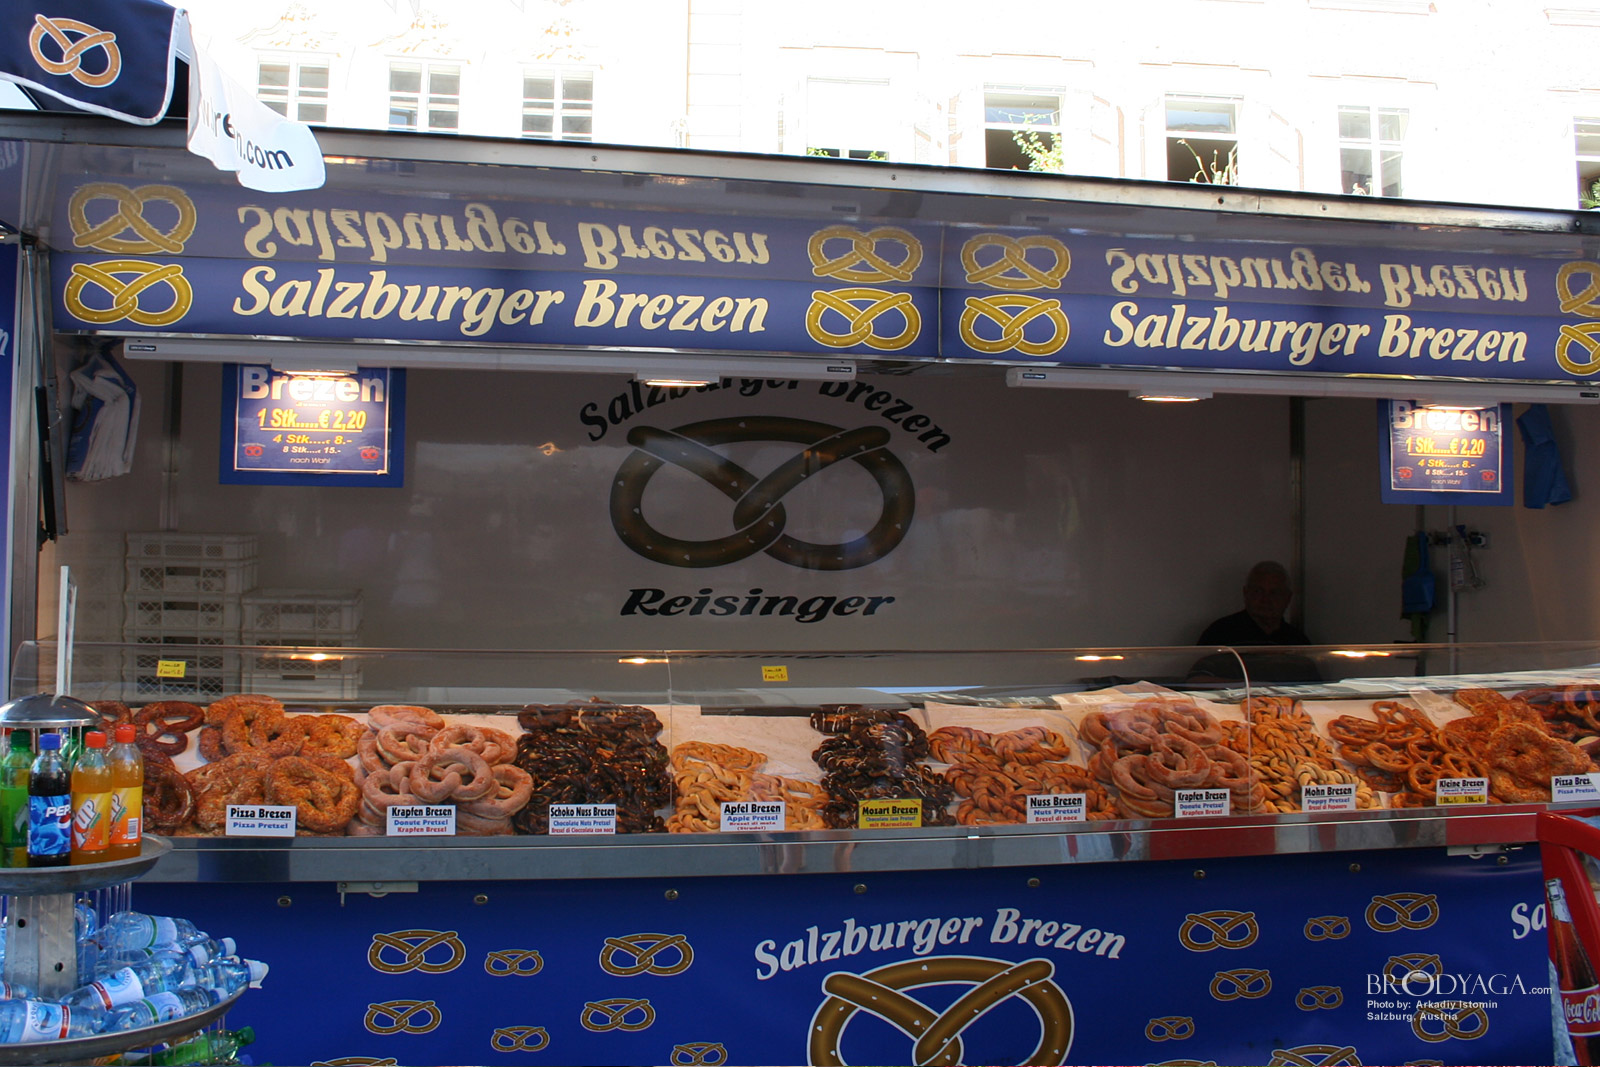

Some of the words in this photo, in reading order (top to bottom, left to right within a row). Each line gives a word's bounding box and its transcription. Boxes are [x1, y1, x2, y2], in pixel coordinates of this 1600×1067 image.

[232, 265, 565, 337] Salzburger
[574, 279, 769, 333] Brezen
[1103, 301, 1371, 367] Salzburger
[1378, 314, 1527, 363] Brezen
[242, 366, 384, 402] Brezen
[257, 408, 267, 427] 1
[333, 410, 367, 431] 2,20
[1393, 400, 1497, 432] Brezen
[273, 434, 282, 444] 4
[1406, 436, 1413, 453] 1
[1460, 438, 1485, 456] 2,20
[1418, 459, 1425, 467] 4
[620, 588, 895, 623] Reisinger
[1439, 780, 1461, 788] Kleine
[1555, 778, 1573, 786] Pizza
[1177, 792, 1203, 802] Krapfen
[1205, 791, 1227, 800] Brezen
[1305, 787, 1325, 796] Mohn
[1327, 787, 1352, 795] Brezen
[1030, 797, 1051, 807] Nuss
[1053, 797, 1083, 806] Brezen
[46, 804, 71, 817] PEP
[230, 808, 255, 817] Pizza
[258, 808, 292, 819] Brezen
[391, 807, 424, 818] Krapfen
[425, 807, 453, 816] Brezen
[550, 807, 574, 817] Schoko
[576, 807, 592, 816] Nuss
[593, 807, 615, 816] Brezen
[724, 804, 749, 815] Apfel
[751, 804, 781, 813] Brezen
[862, 807, 890, 815] Mozart
[892, 806, 919, 814] Brezen
[754, 916, 983, 980] Salzburger
[989, 907, 1126, 959] Brezen
